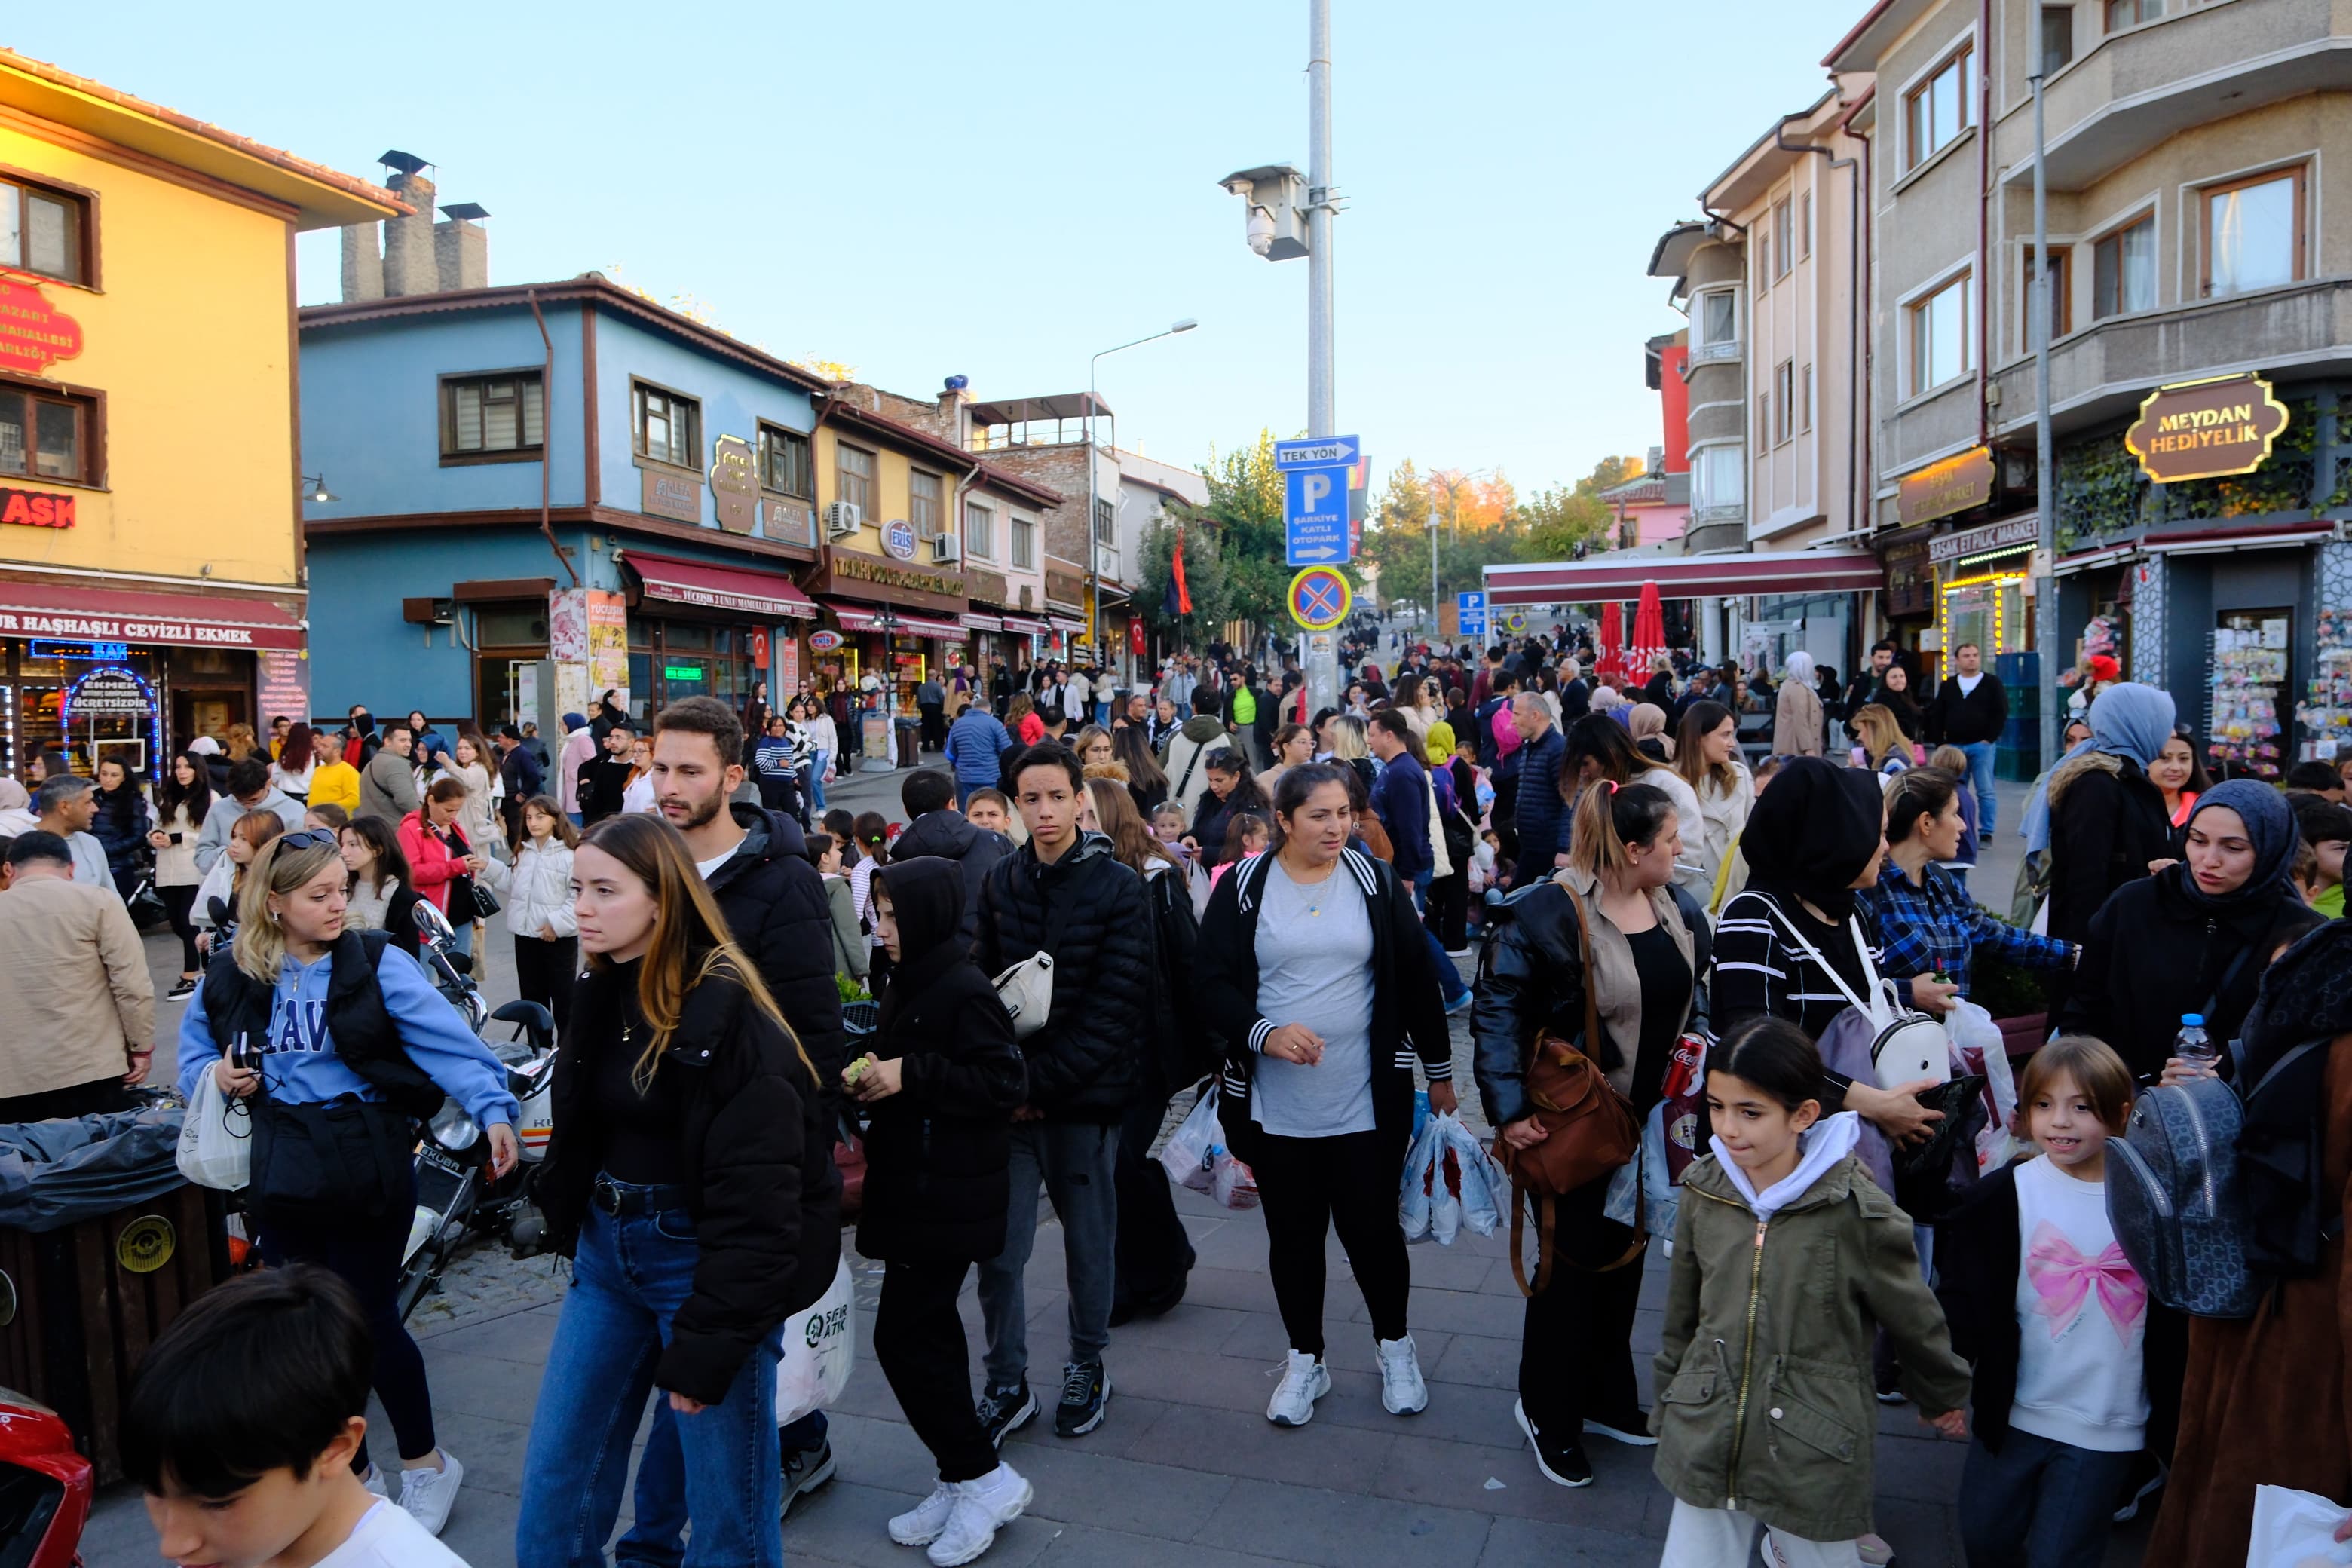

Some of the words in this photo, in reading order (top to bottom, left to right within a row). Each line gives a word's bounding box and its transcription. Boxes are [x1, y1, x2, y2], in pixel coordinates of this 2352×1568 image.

[2158, 403, 2252, 433] MEYDAN
[2151, 422, 2259, 453] HEDİYELİK
[1283, 451, 1308, 461] TEK
[1312, 447, 1337, 459] YÖN
[1303, 474, 1331, 513] P
[1294, 514, 1339, 525] ŞARKİYE
[1301, 525, 1331, 534] KATLI
[893, 526, 912, 555] ERİŞ
[1292, 534, 1340, 544] OTOPARK
[1930, 538, 1958, 559] BAŞAK
[1961, 535, 1972, 552] ET
[1998, 519, 2039, 543] MARKET
[715, 595, 720, 605] 2
[1468, 595, 1479, 608] P
[23, 616, 119, 638] HAŞHAŞLI
[124, 622, 191, 640] CEVİZLİ
[195, 627, 253, 643] EKMEK
[73, 697, 148, 707] ÜCRETSİZDİR
[427, 1150, 460, 1171] KUBA
